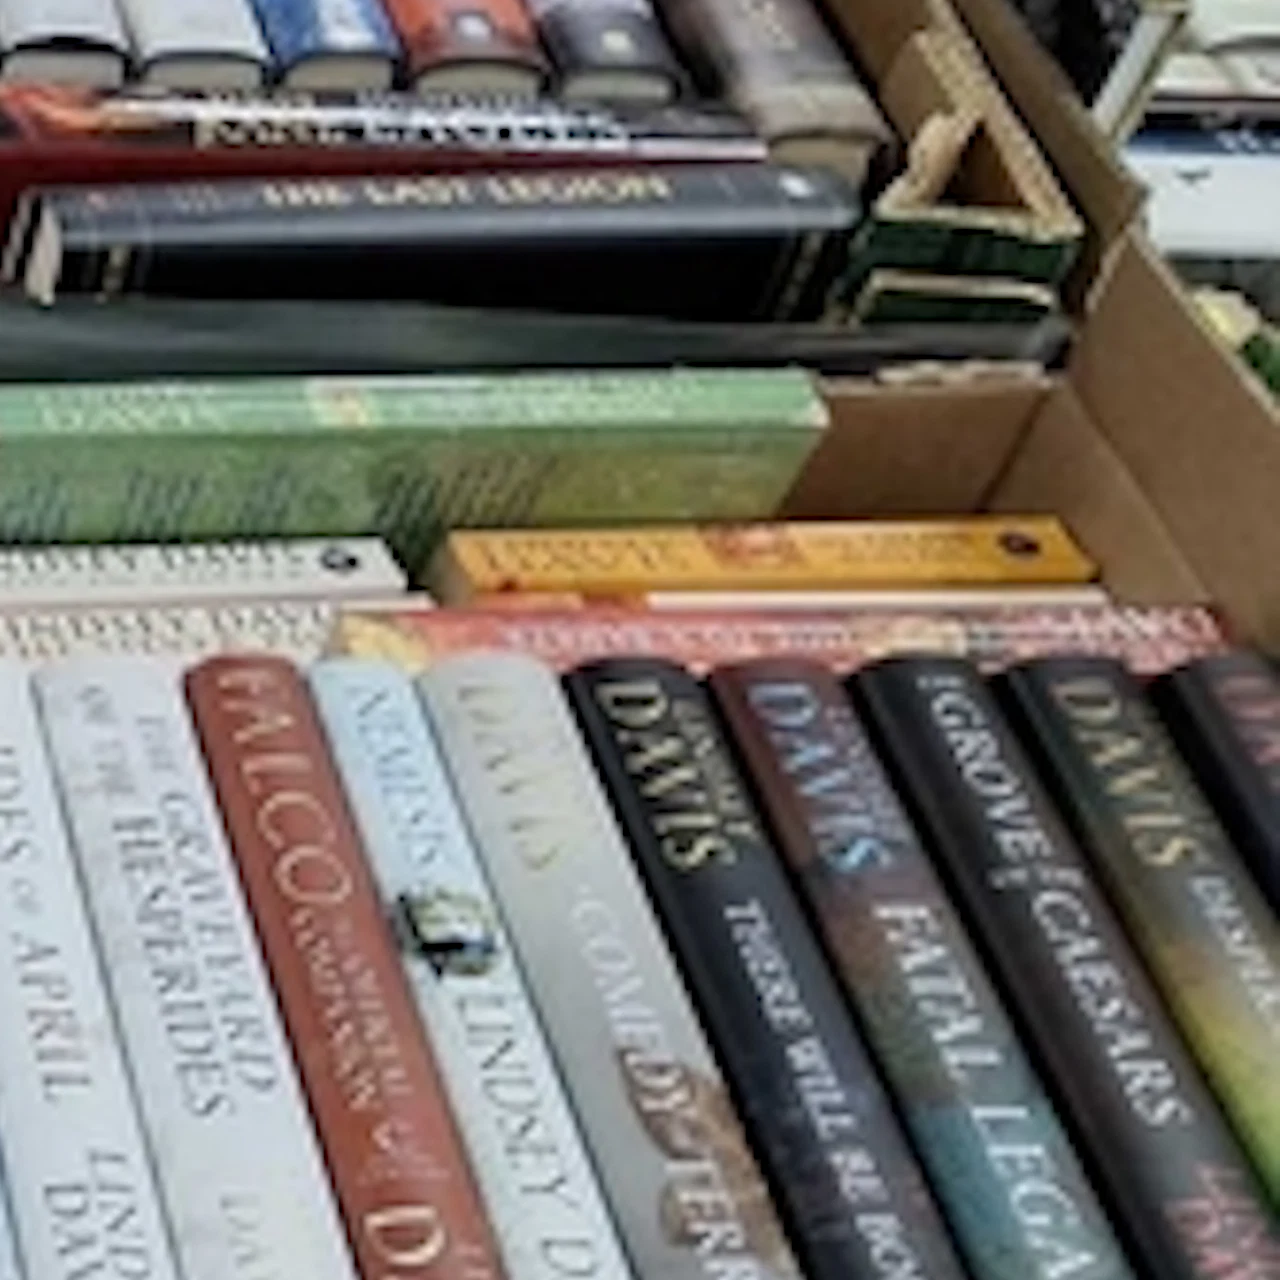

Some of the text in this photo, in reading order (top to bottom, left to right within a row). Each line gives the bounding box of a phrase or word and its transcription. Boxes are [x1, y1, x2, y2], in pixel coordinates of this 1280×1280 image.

[215, 665, 353, 907] FALCO
[456, 678, 568, 876] DAVIS
[746, 680, 894, 874] DAVIS
[870, 901, 1006, 1086] FATAL
[1048, 674, 1200, 872] DAVIS
[10, 937, 100, 1108] APRIL
[112, 814, 232, 1120] HESPERIDES
[595, 678, 737, 873] DAVIS
[722, 898, 812, 1032] THERE
[784, 1032, 866, 1142] WILL
[930, 694, 1198, 1132] GROVE CAESARS
[452, 990, 574, 1220] LINDSEY
